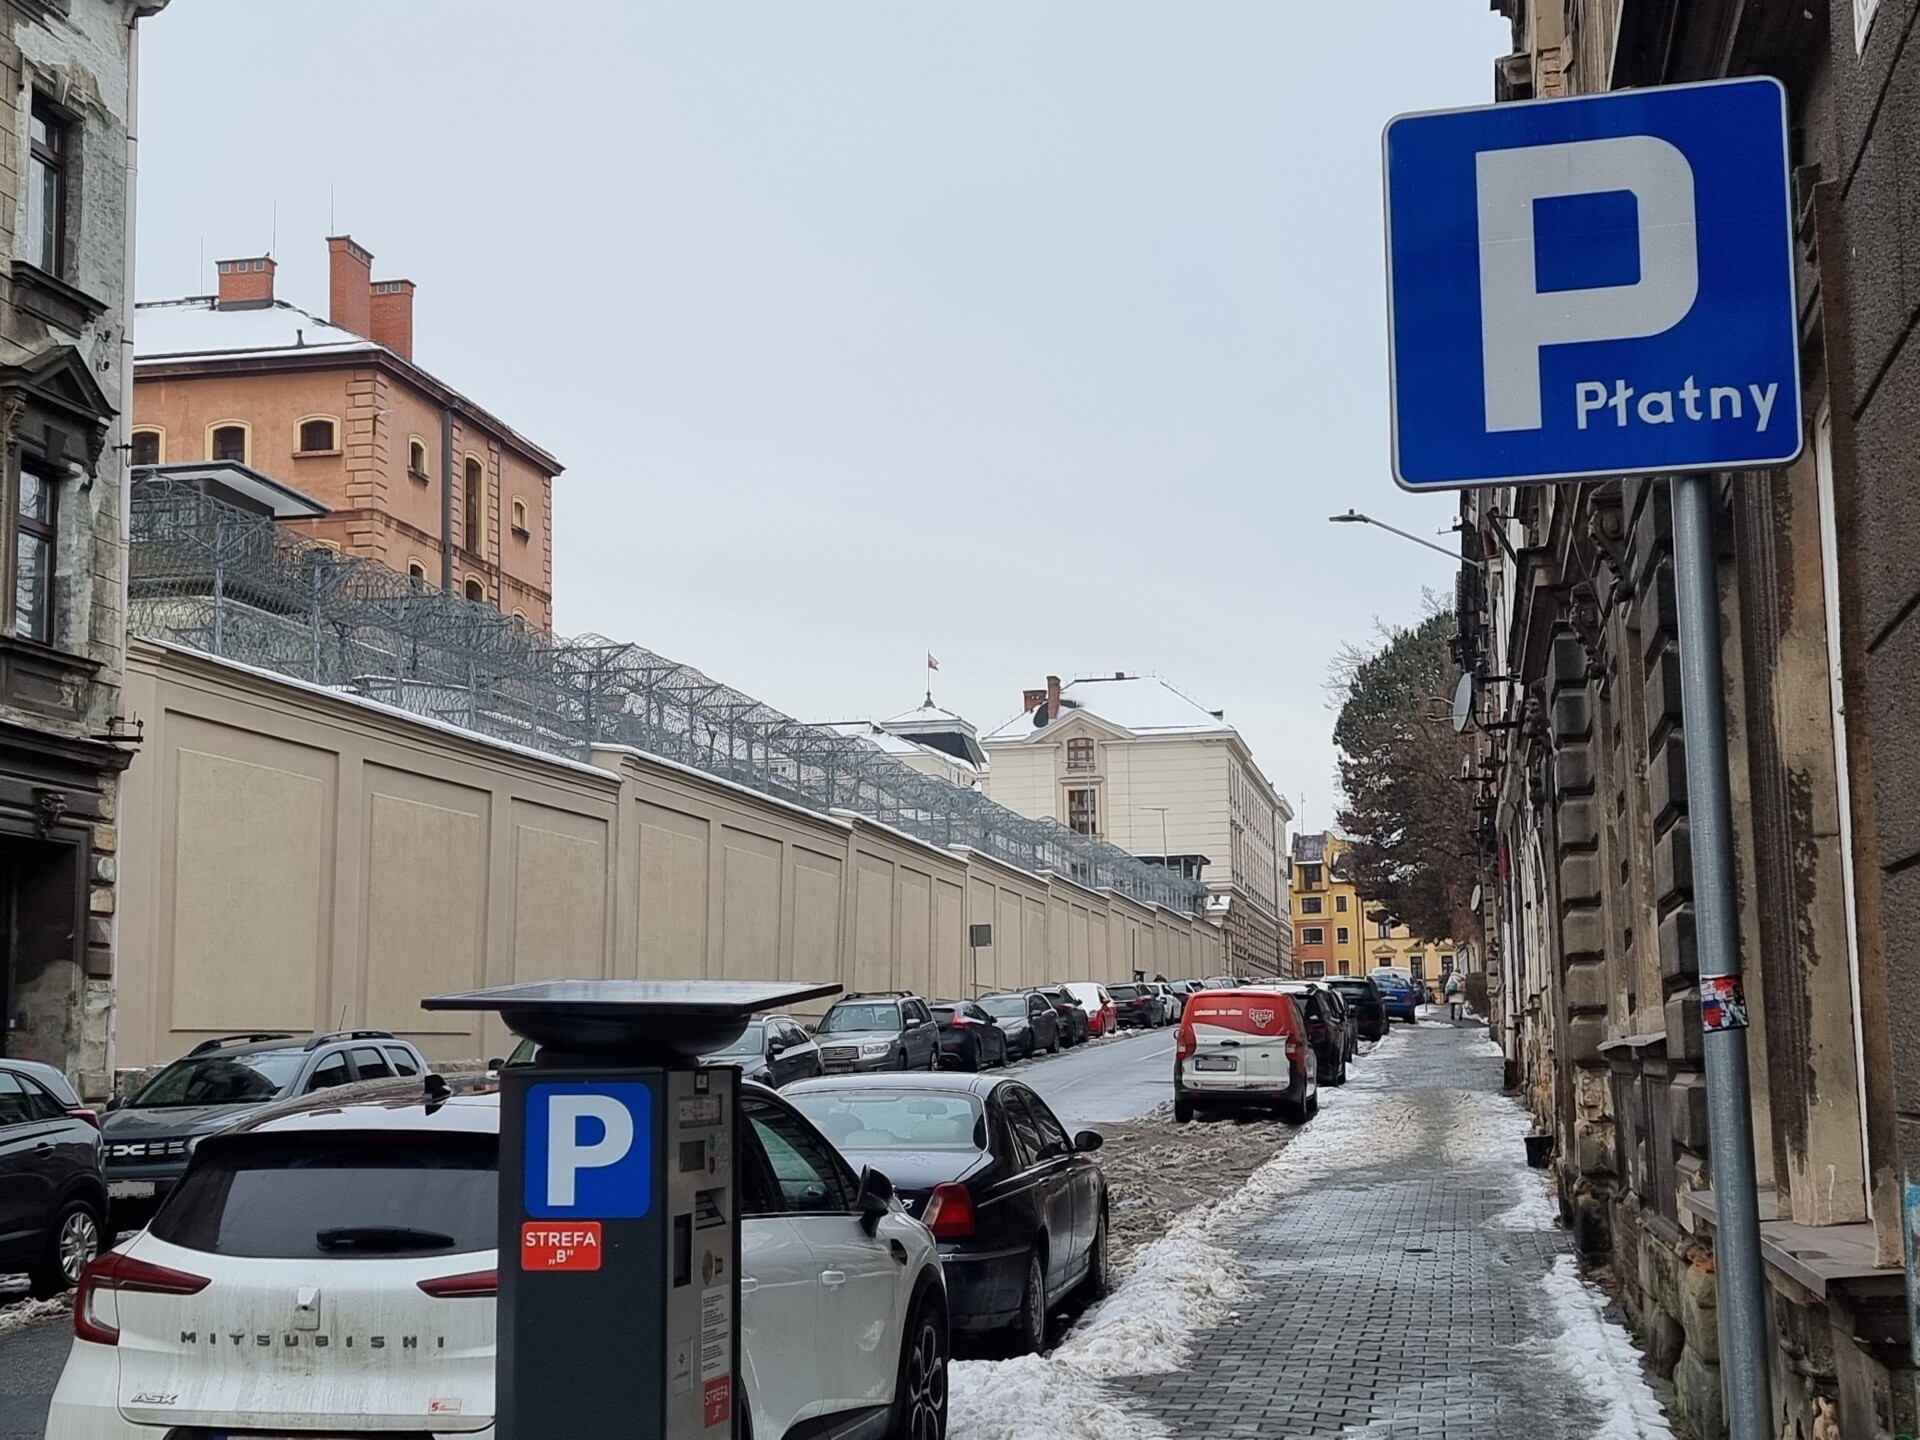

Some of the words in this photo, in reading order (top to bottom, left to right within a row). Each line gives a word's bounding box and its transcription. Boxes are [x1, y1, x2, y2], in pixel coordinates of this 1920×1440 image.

[1475, 134, 1699, 433] P
[1575, 374, 1778, 432] Płatny
[547, 1094, 634, 1207] P
[525, 1231, 597, 1247] STREFA
[180, 1331, 444, 1348] MITSUBISHI
